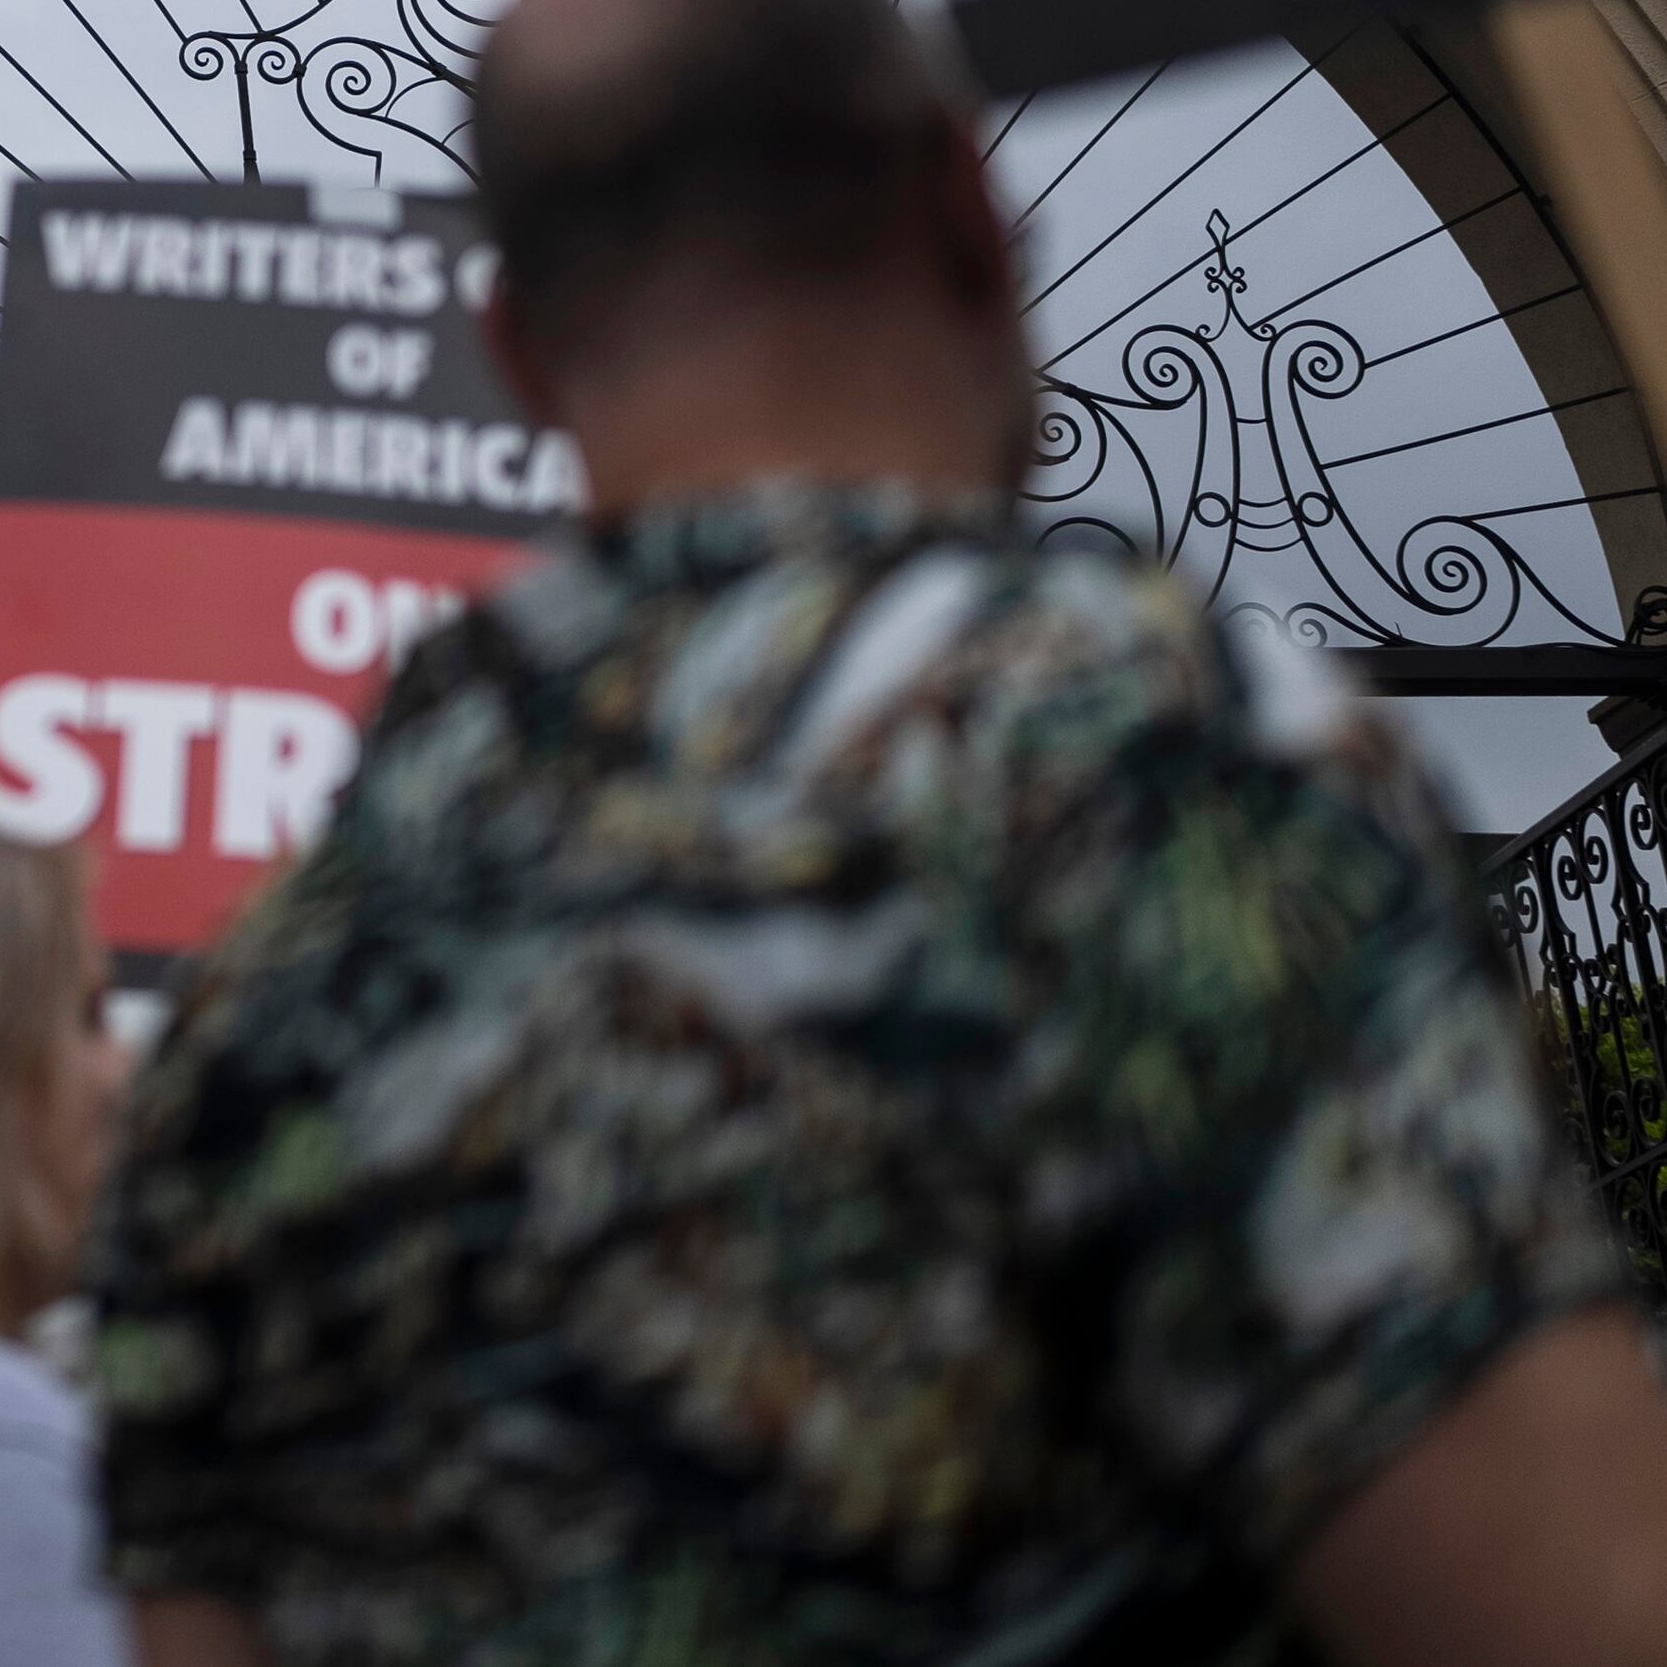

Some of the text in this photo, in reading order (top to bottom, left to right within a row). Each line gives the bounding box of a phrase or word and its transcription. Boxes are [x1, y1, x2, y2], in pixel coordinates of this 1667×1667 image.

[43, 210, 444, 313] WRITERS
[327, 322, 433, 398] OF
[162, 398, 591, 510] AMERICA
